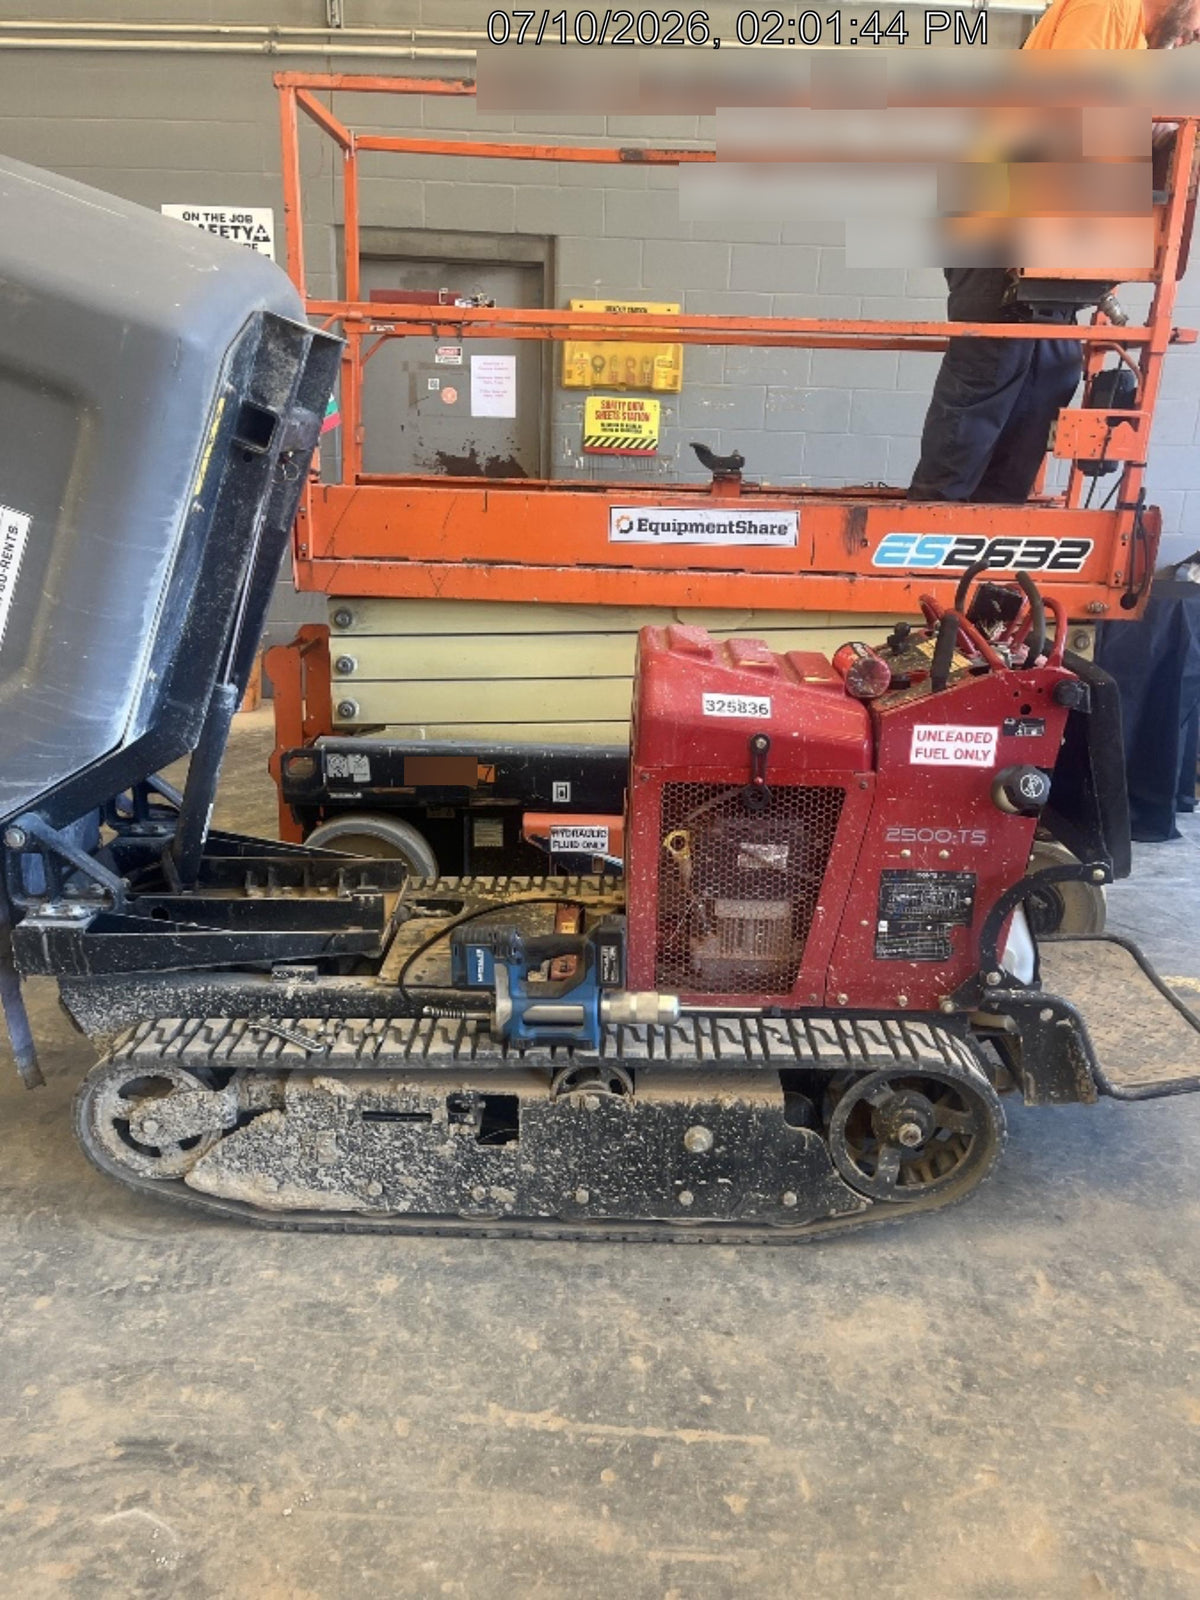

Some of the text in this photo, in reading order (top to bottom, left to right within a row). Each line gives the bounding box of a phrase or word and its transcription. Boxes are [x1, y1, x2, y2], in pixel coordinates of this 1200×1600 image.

[182, 211, 253, 224] ON THE JOB
[198, 223, 254, 240] FETY
[636, 517, 788, 536] EquipmentShare
[872, 534, 1092, 571] ES2632
[705, 699, 769, 715] 325836
[916, 730, 993, 744] UNLEADED
[914, 747, 991, 761] FUEL ONLY
[551, 828, 607, 838] HYDRAULIC
[552, 840, 605, 850] FLUID ONLY
